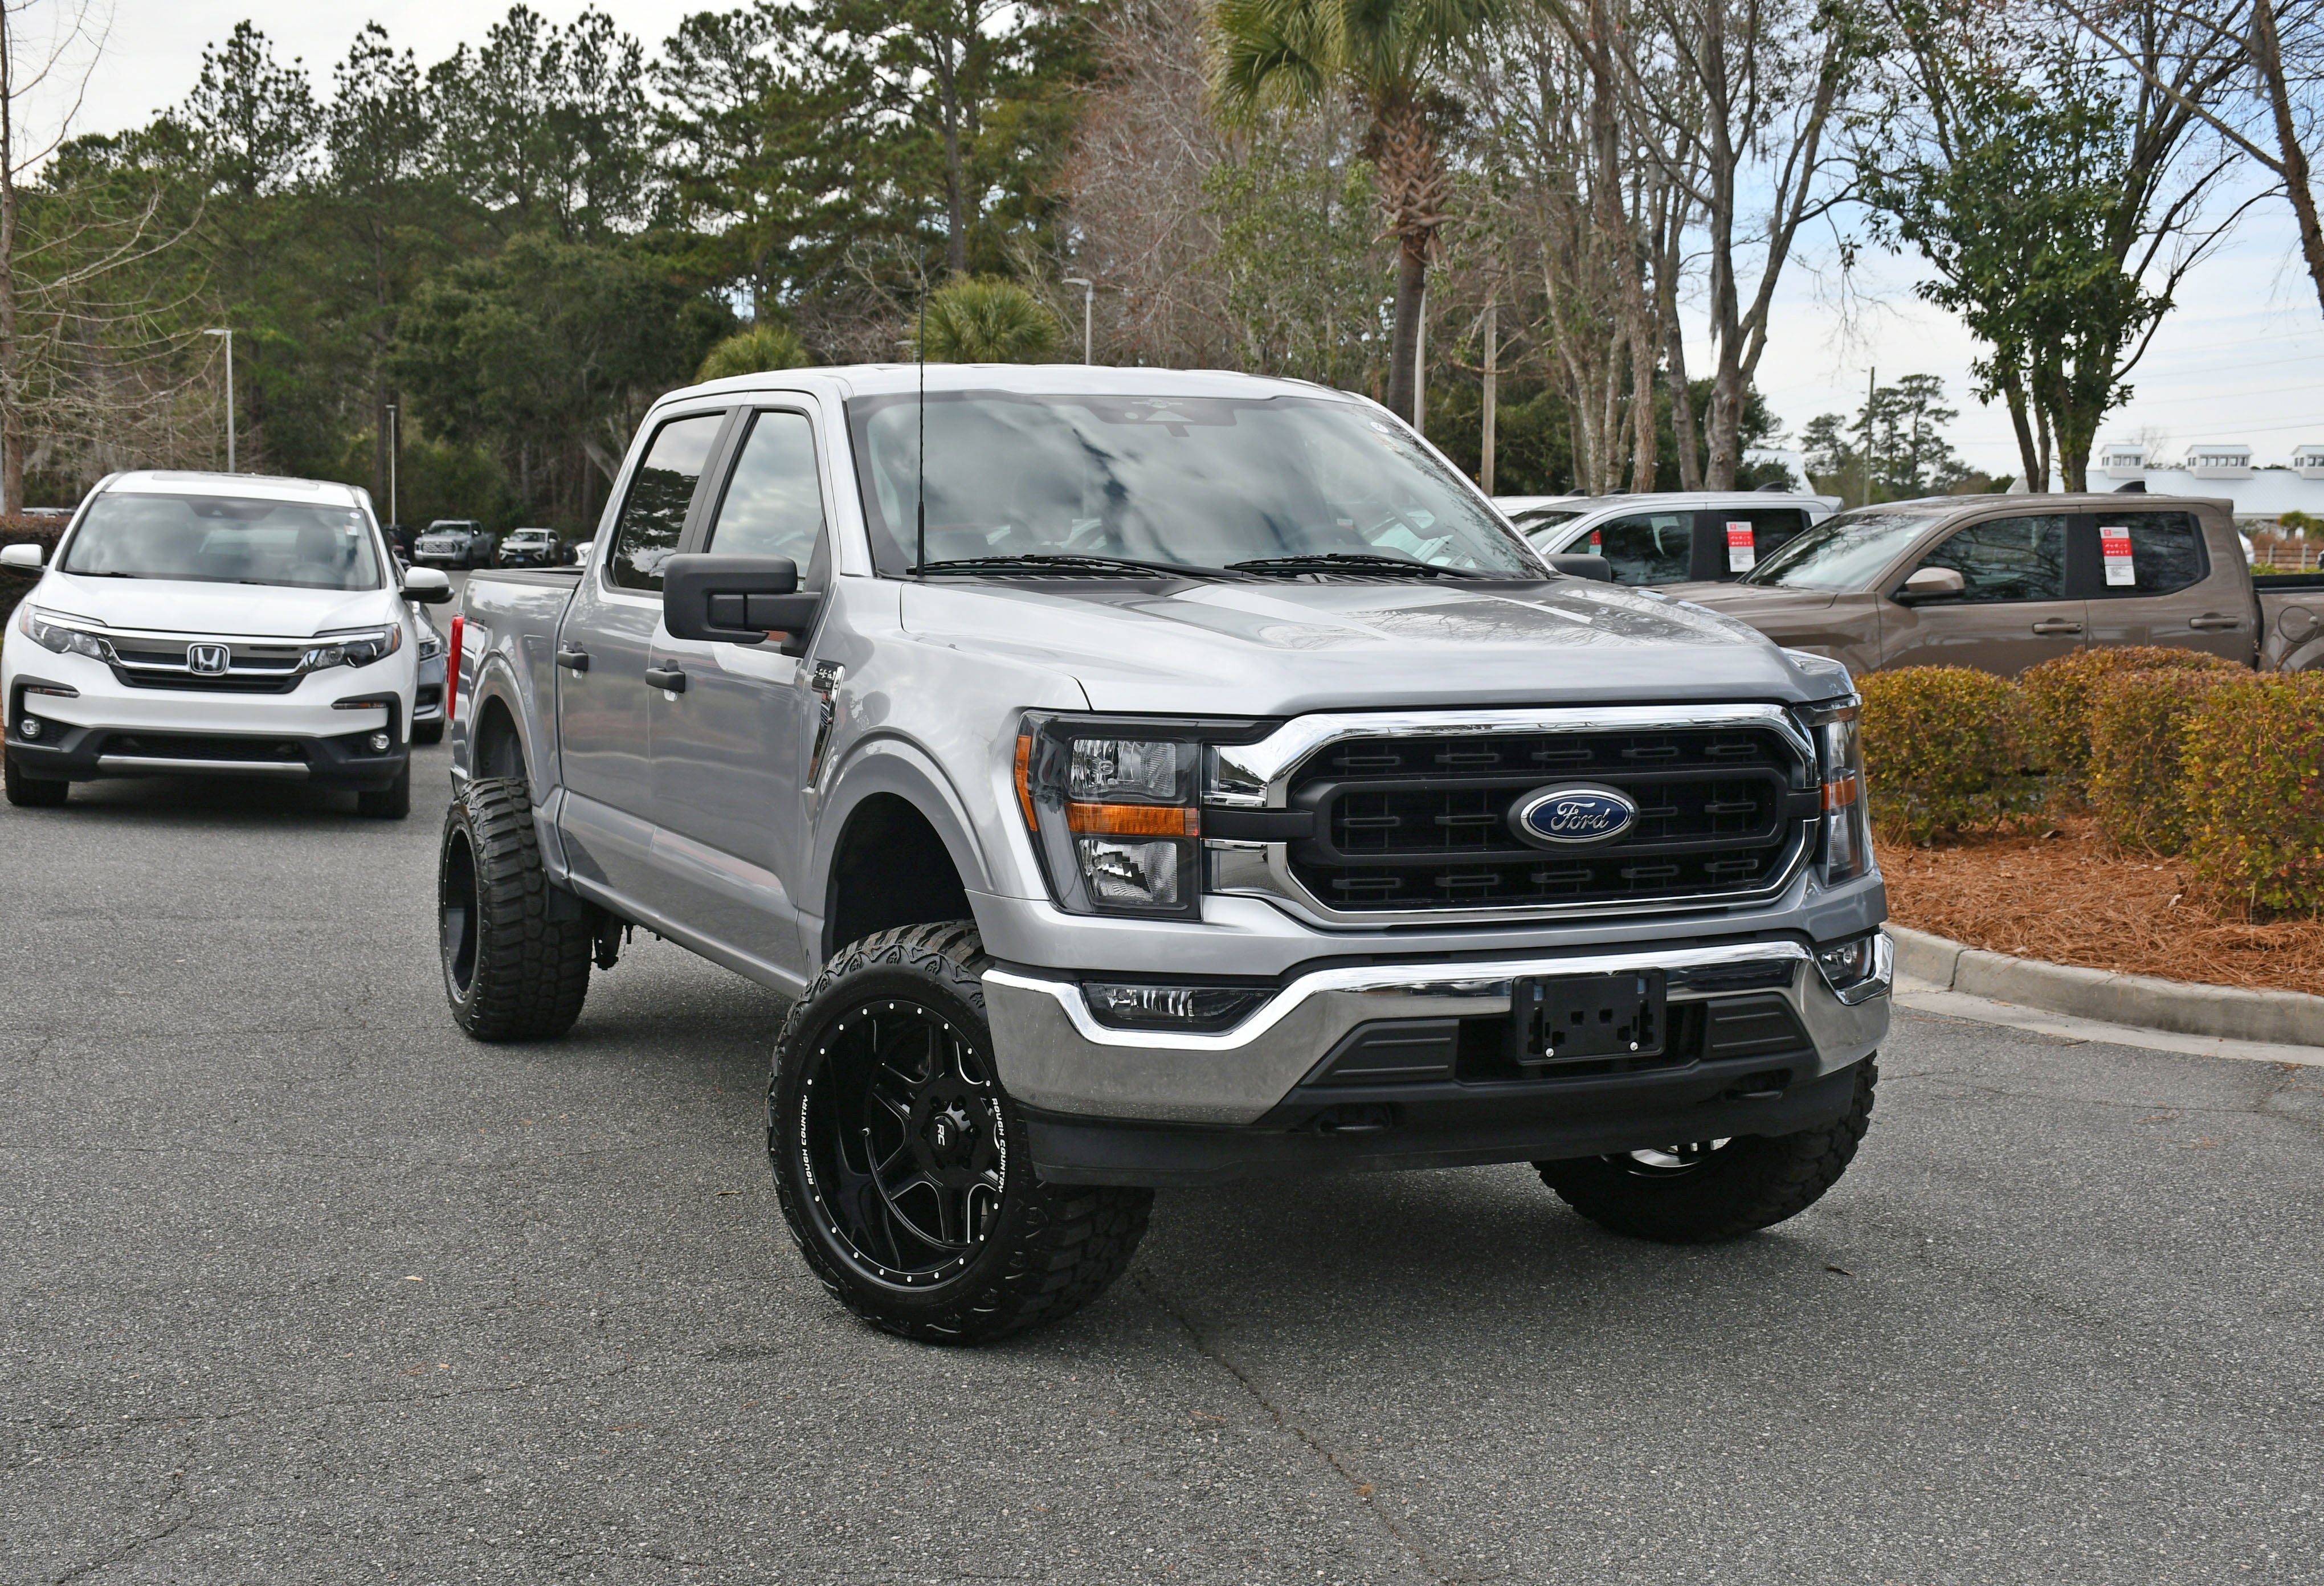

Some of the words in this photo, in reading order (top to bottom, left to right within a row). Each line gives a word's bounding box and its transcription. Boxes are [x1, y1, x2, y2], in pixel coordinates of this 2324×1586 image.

[1550, 801, 1611, 831] Ford
[937, 1123, 945, 1146] RC
[991, 1098, 1004, 1136] ROUGH
[998, 1139, 1006, 1193] COUNTRY
[802, 1148, 814, 1185] ROUGH
